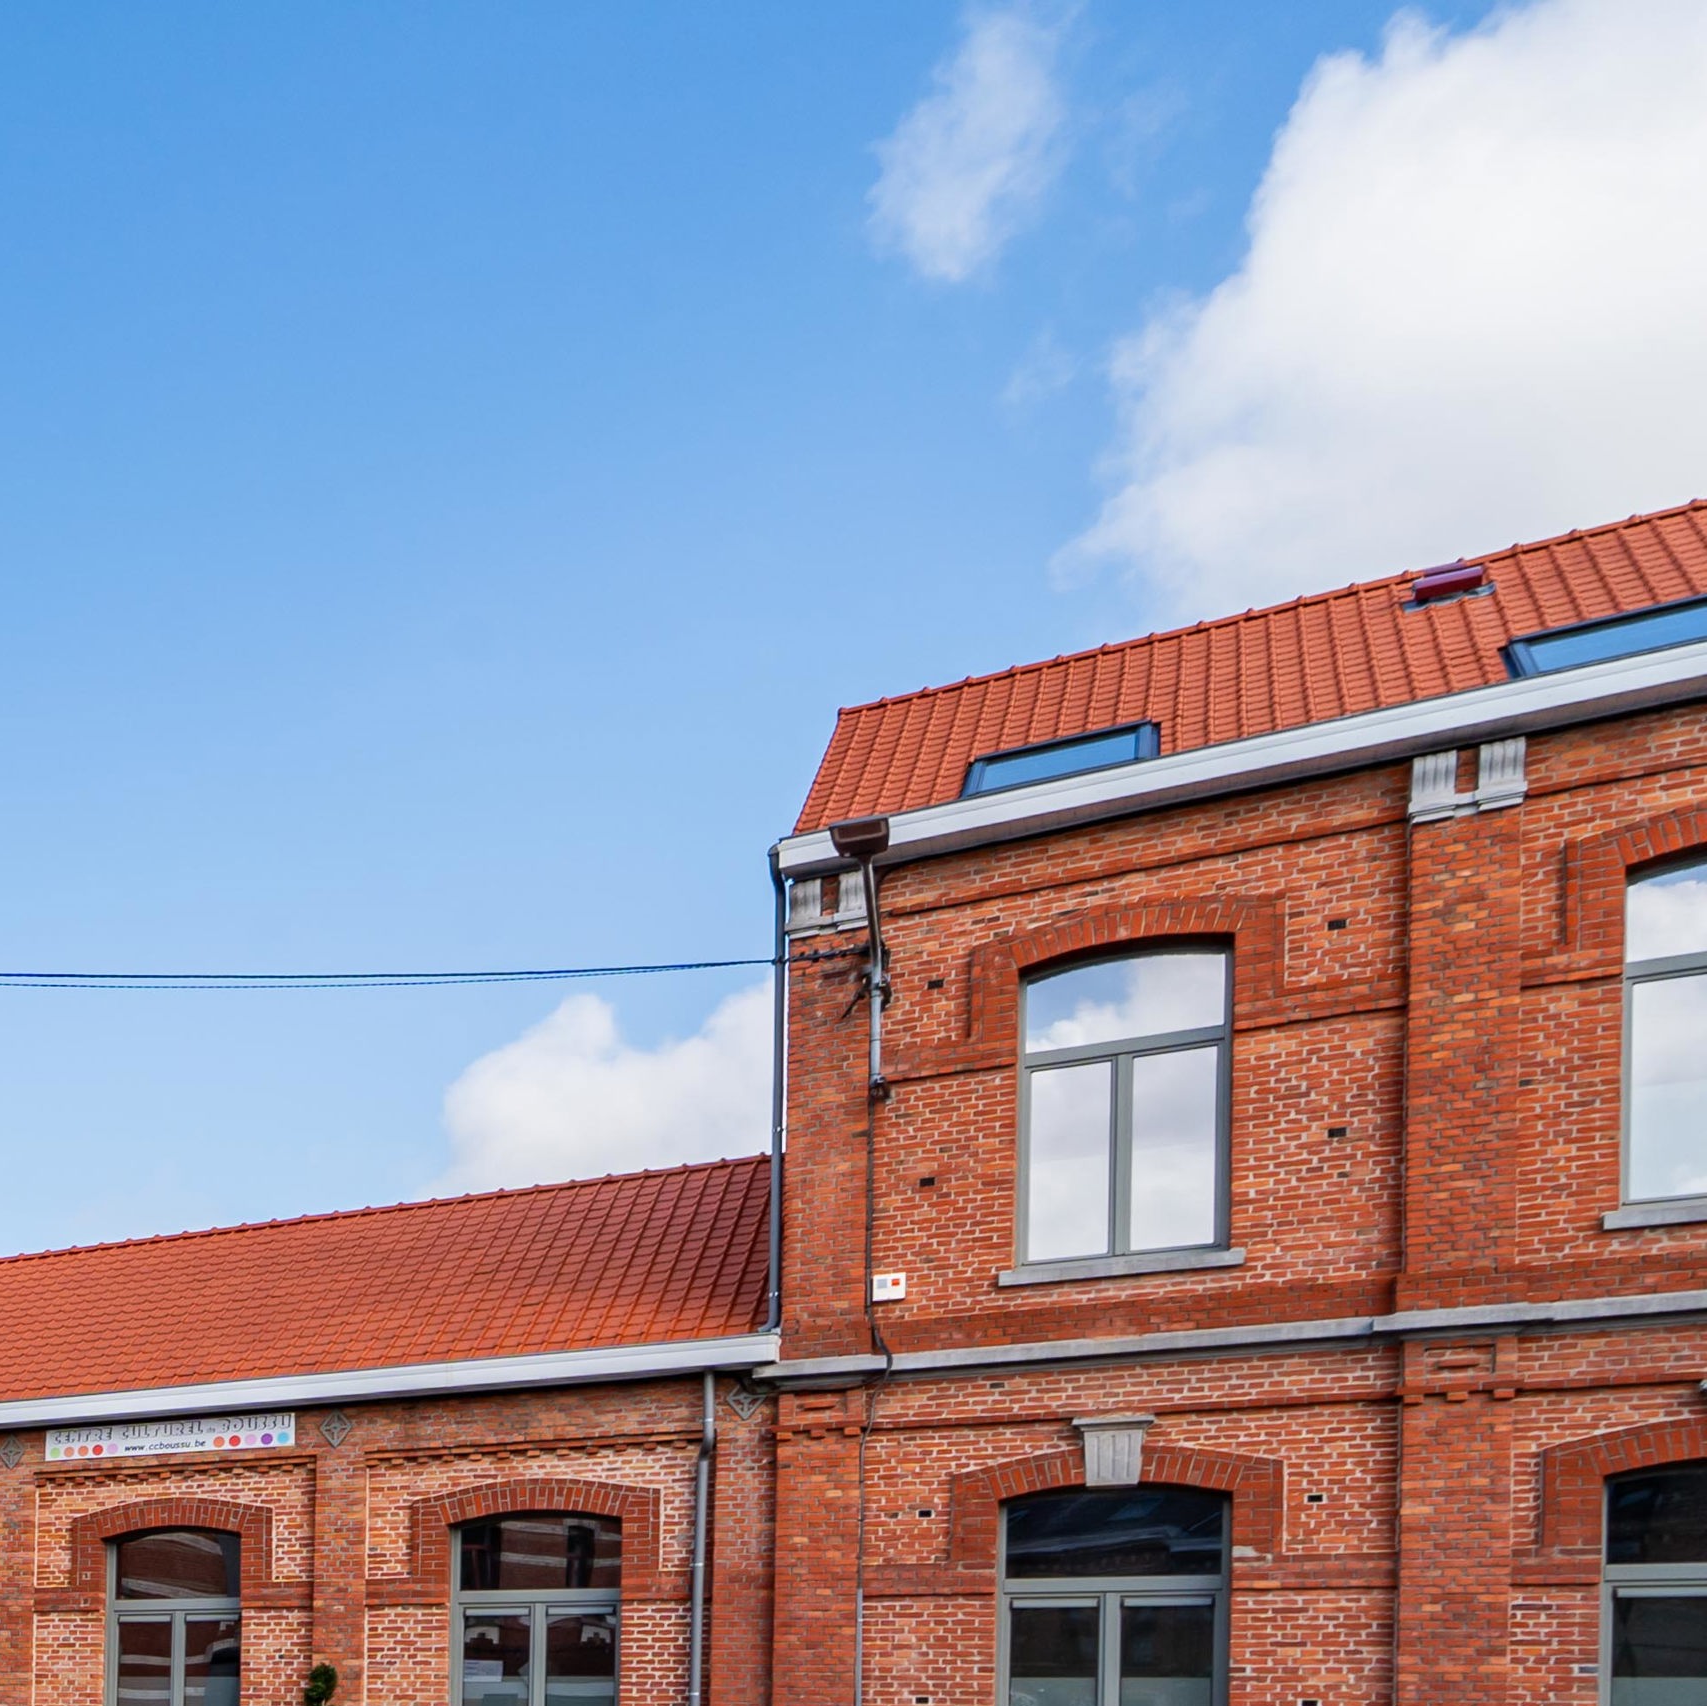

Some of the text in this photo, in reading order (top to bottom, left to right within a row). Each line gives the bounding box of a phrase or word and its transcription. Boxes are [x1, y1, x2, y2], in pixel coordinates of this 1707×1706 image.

[53, 1427, 113, 1444] CENTRE
[122, 1420, 203, 1440] CULTUREL
[217, 1414, 292, 1434] BOUSSU
[124, 1439, 206, 1452] www.ccboussu.be
